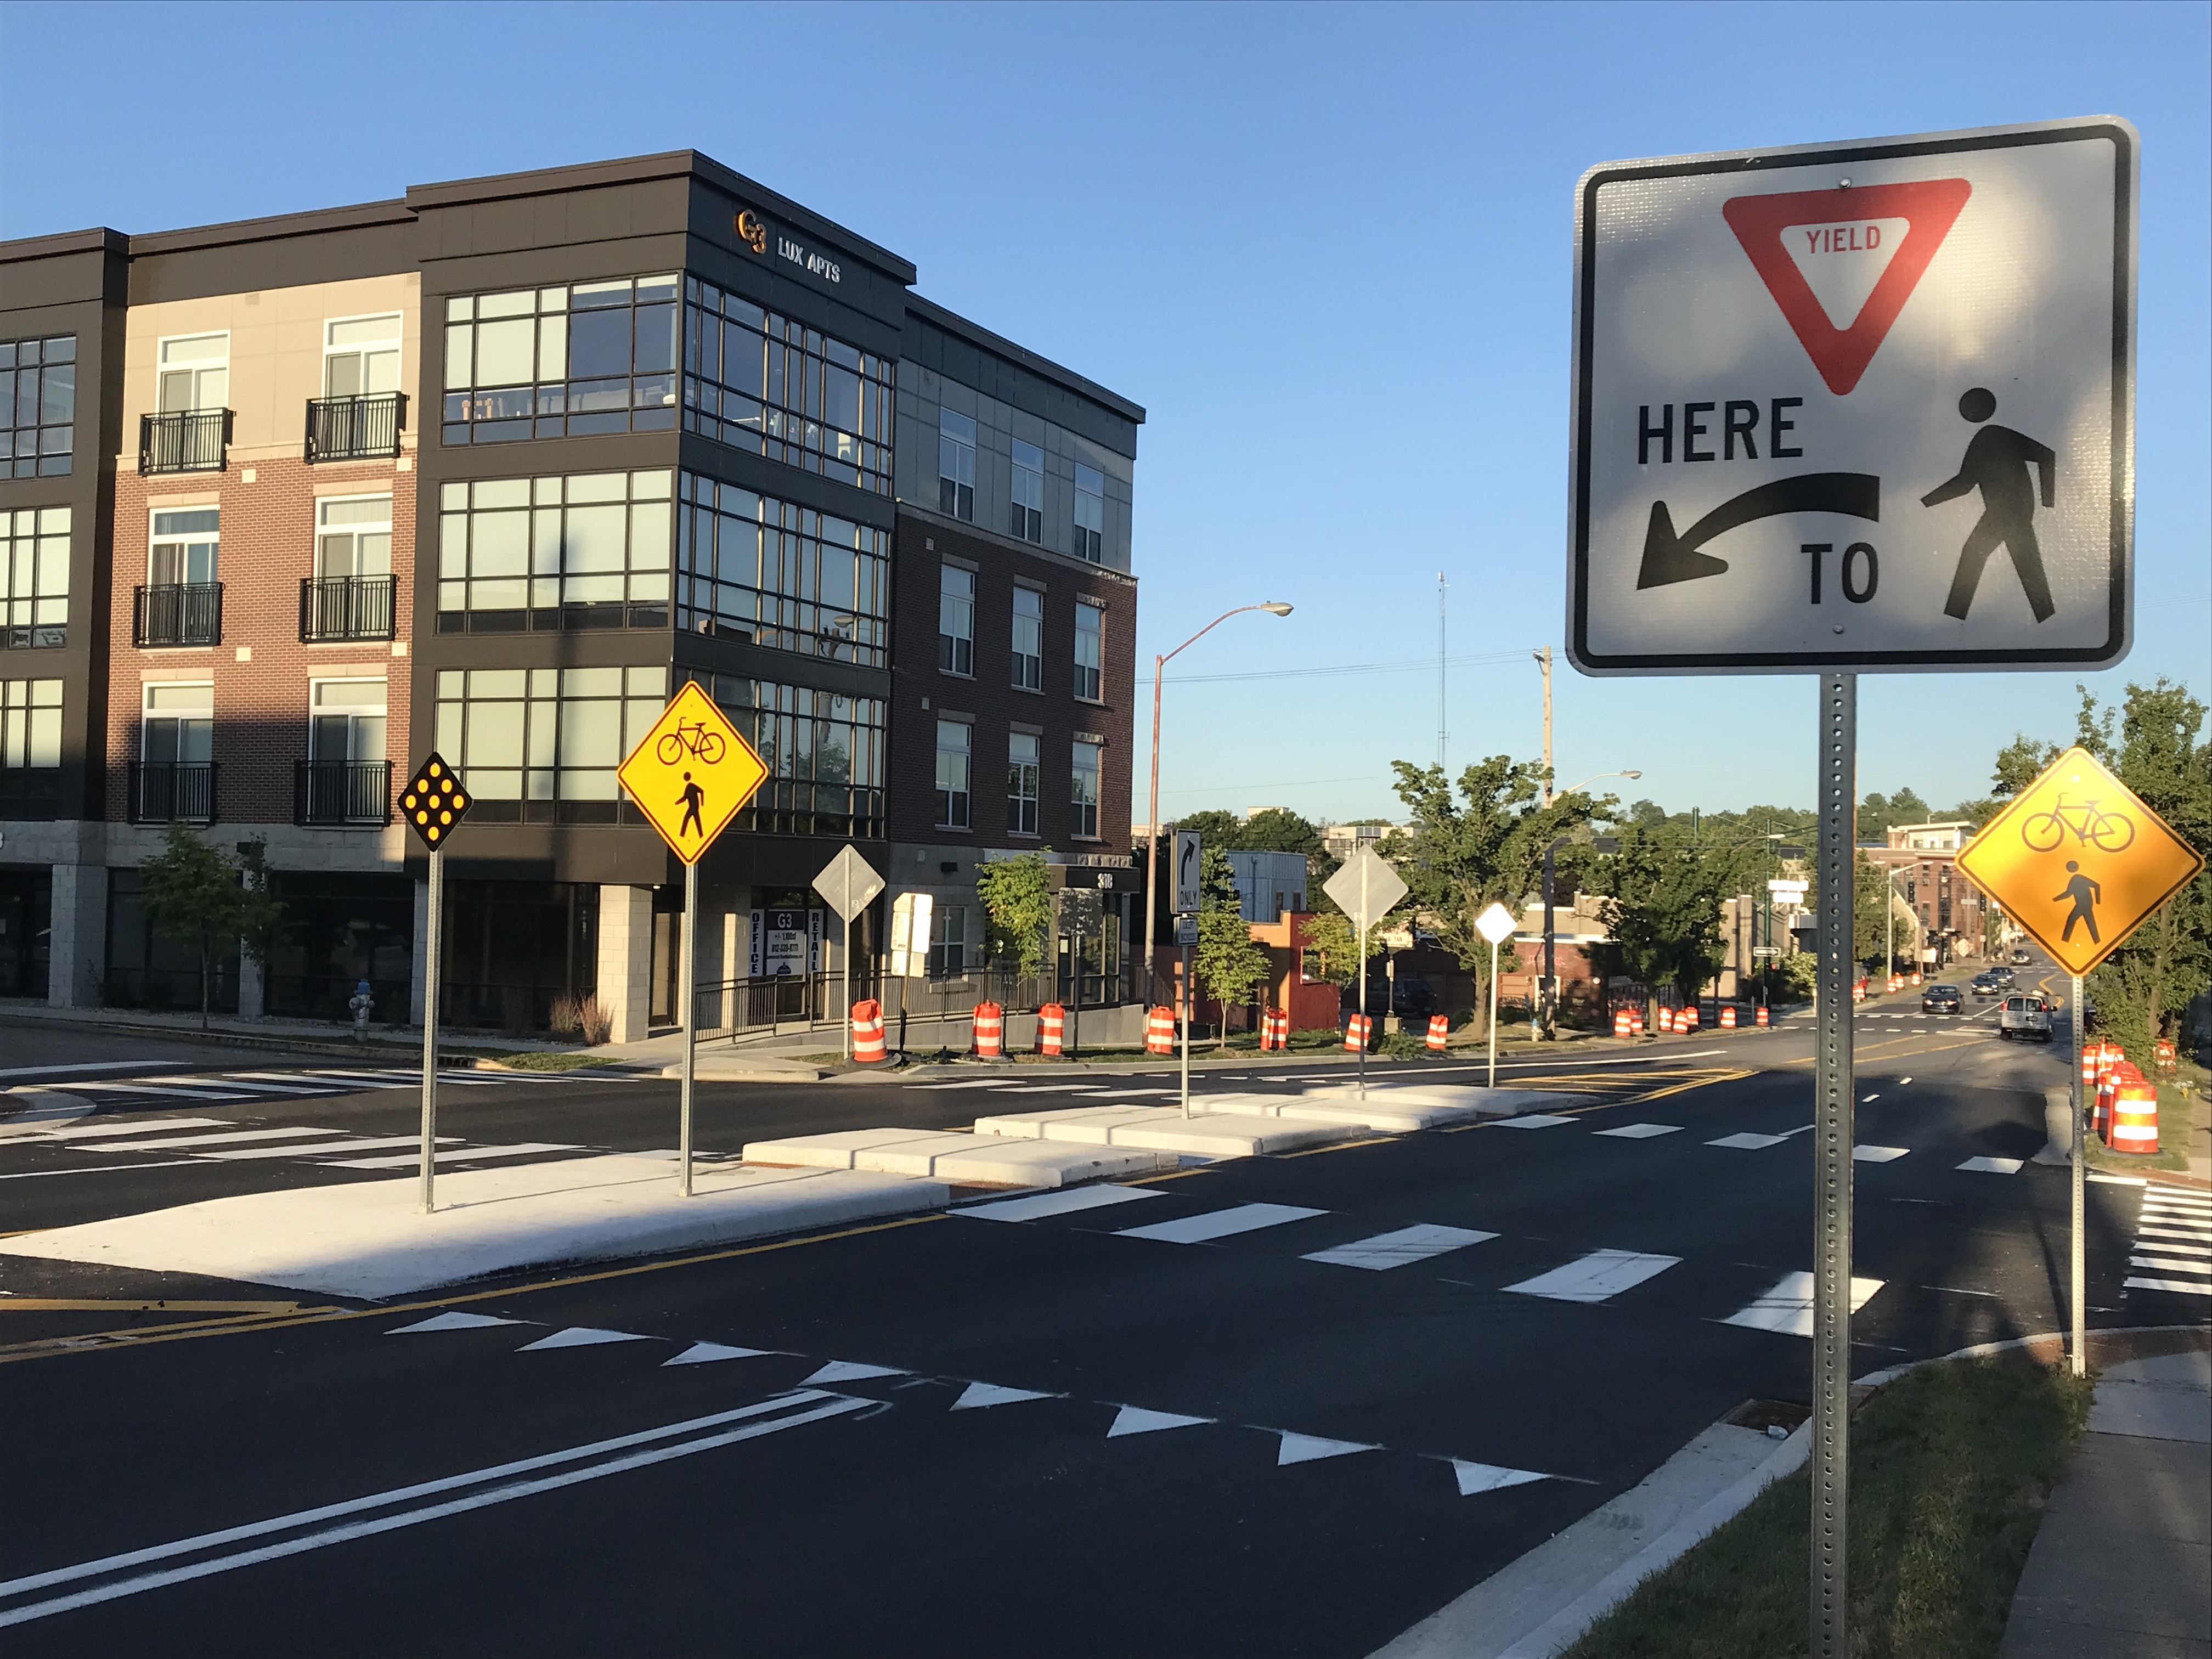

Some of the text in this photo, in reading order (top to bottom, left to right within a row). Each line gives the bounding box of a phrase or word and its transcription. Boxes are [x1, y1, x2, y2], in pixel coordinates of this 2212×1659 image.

[738, 209, 767, 254] G3
[1805, 225, 1881, 254] YIELD
[778, 236, 841, 283] LUX APTS
[1637, 397, 1804, 465] HERE
[1801, 541, 1880, 605] TO
[1098, 873, 1113, 889] 318
[1180, 890, 1197, 906] ONLY
[751, 912, 760, 974] OFFICE
[777, 913, 792, 928] G3
[811, 912, 819, 971] RETAIL
